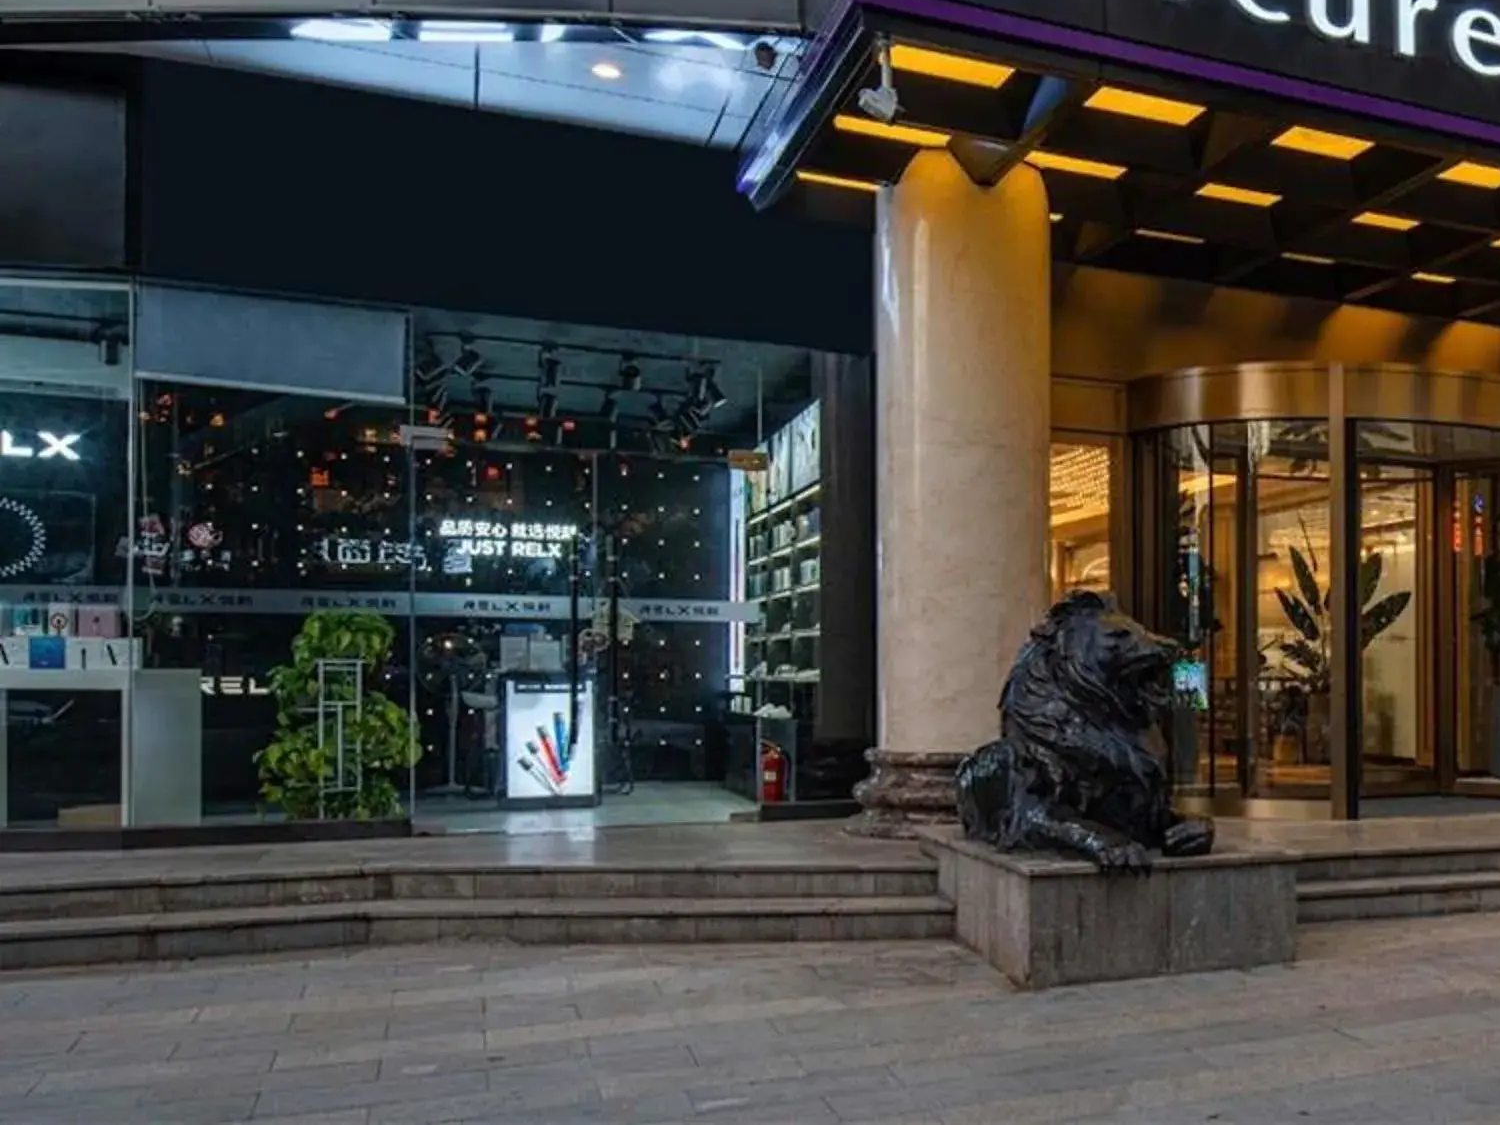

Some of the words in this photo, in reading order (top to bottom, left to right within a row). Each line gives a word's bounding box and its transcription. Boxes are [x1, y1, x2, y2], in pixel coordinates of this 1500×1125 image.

[456, 539, 507, 556] JUST
[511, 540, 562, 558] RELX
[200, 676, 271, 695] REL
